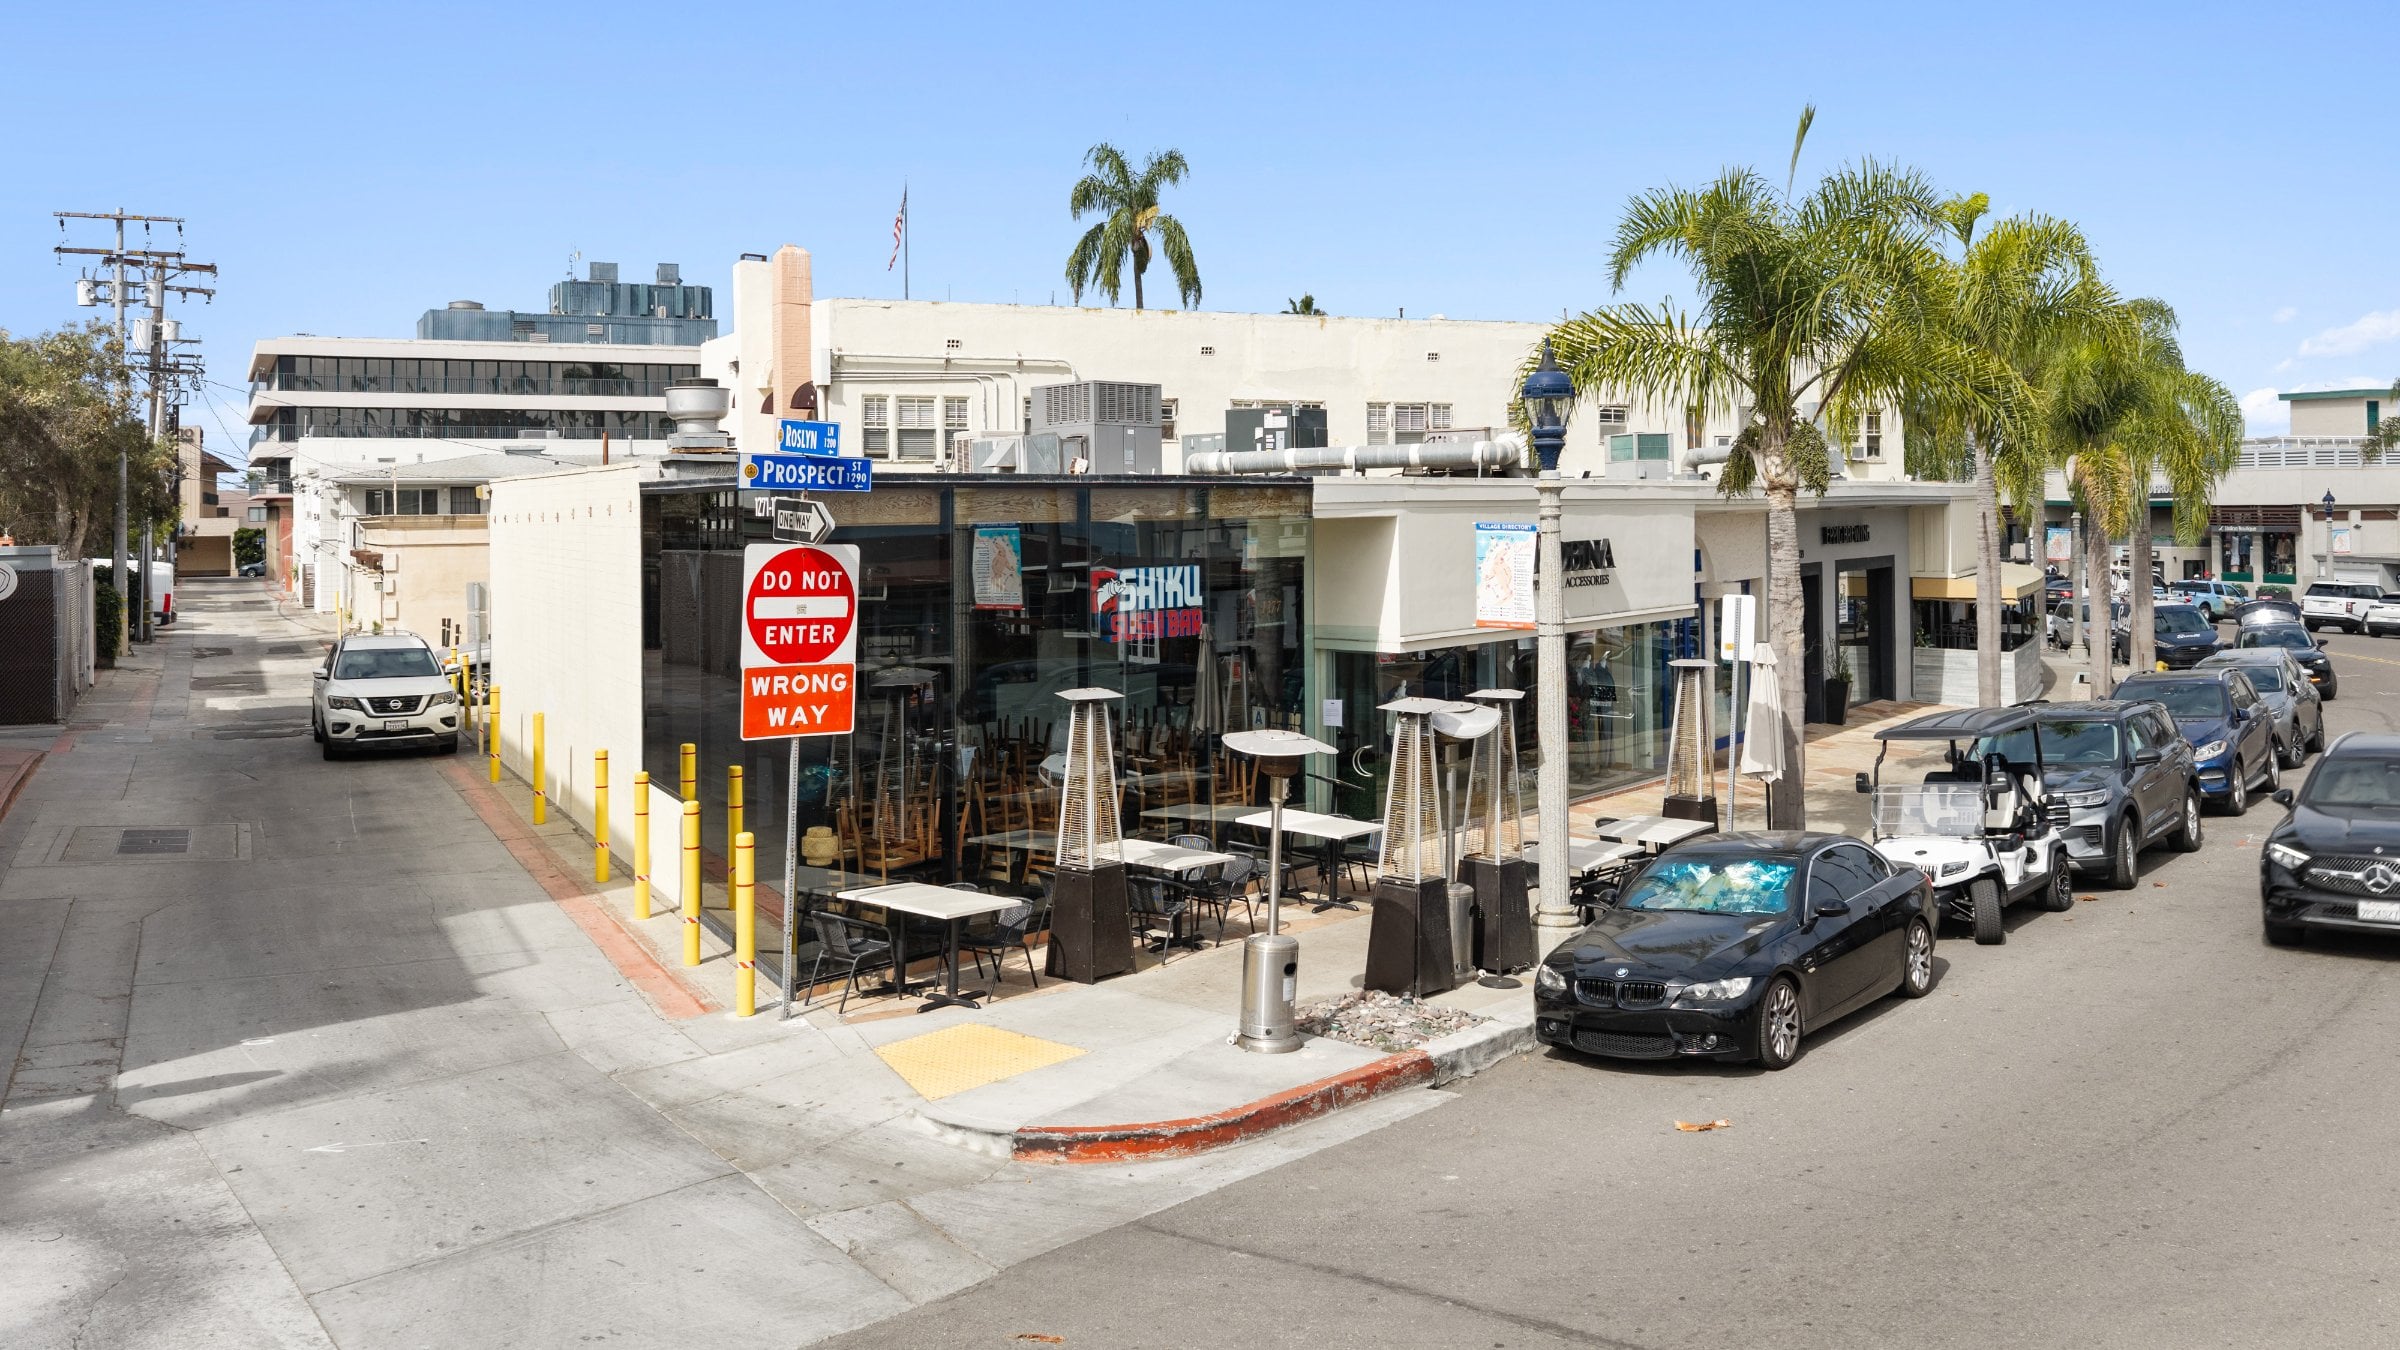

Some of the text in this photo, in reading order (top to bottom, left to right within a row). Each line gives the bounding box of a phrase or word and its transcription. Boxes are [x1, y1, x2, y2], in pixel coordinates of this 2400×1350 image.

[785, 425, 835, 449] ROSLYN LN
[824, 438, 837, 448] 1200
[762, 460, 862, 485] PROSPECT ST
[846, 473, 867, 482] 1290
[754, 496, 777, 517] 1271-1
[779, 512, 811, 531] ONE WAY
[763, 571, 842, 590] DO NOT
[1119, 565, 1203, 611] SHIKU
[1565, 575, 1610, 588] ACCESSORIES
[765, 624, 835, 645] ENTER
[1110, 608, 1202, 642] SUSHI BAR
[751, 673, 847, 696] WRONG
[768, 704, 828, 727] WAY
[1255, 710, 1263, 725] A
